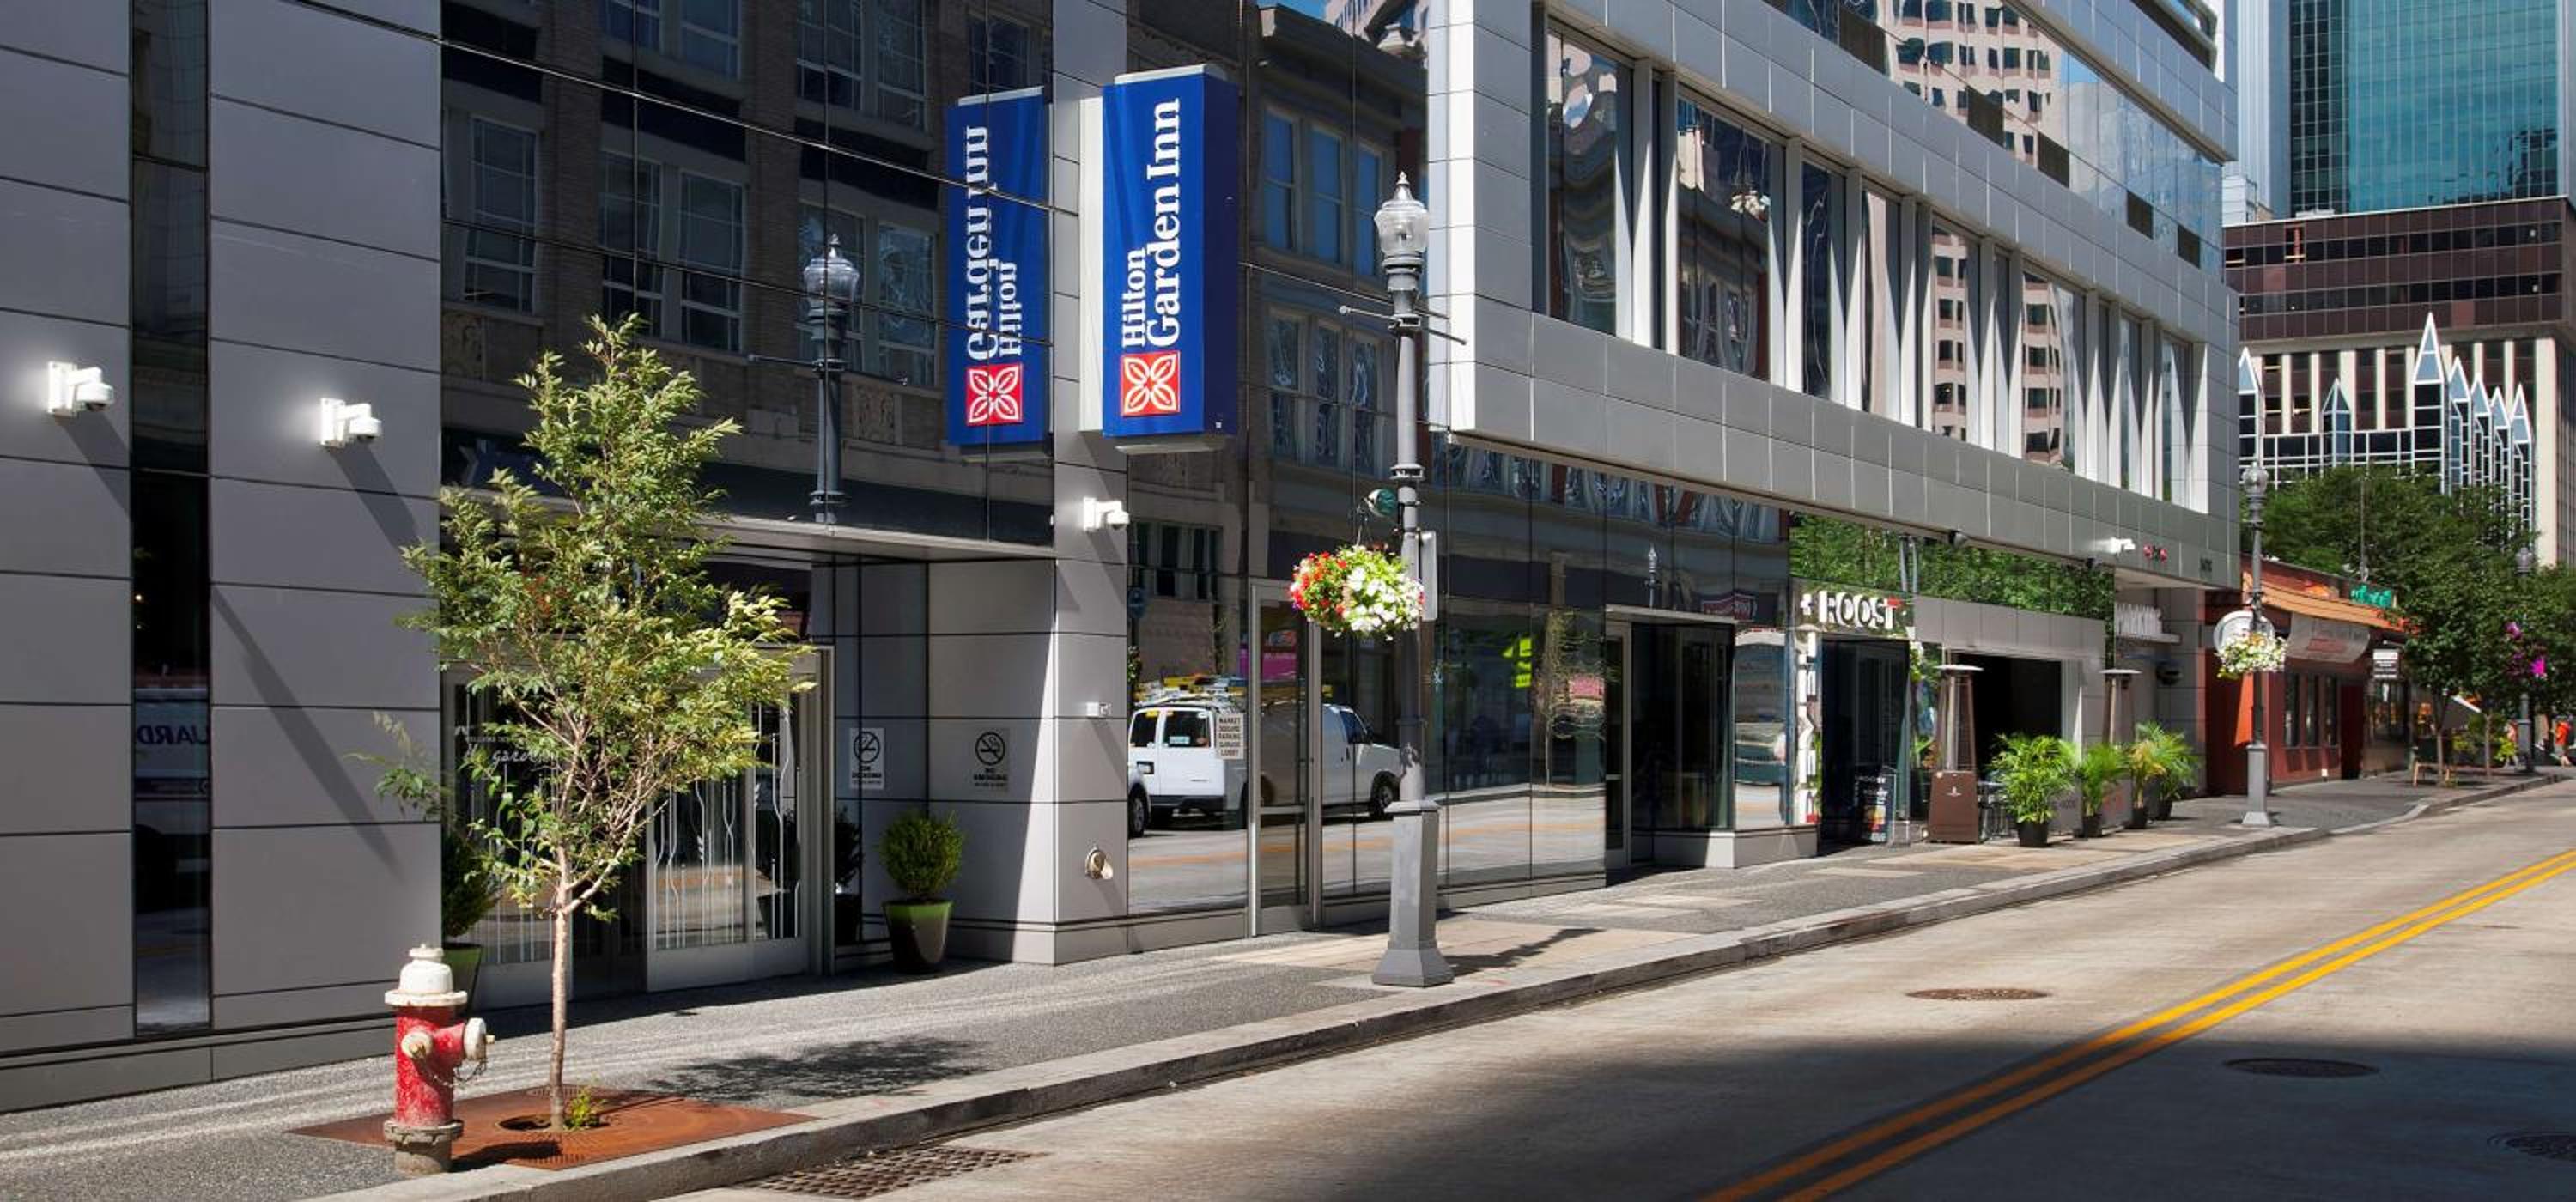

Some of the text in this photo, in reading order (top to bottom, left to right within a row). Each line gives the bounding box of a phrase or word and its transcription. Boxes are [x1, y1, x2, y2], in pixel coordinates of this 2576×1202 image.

[1146, 98, 1181, 347] Garden Inn
[1121, 248, 1146, 348] Hilton
[1819, 591, 1902, 629] ROOST
